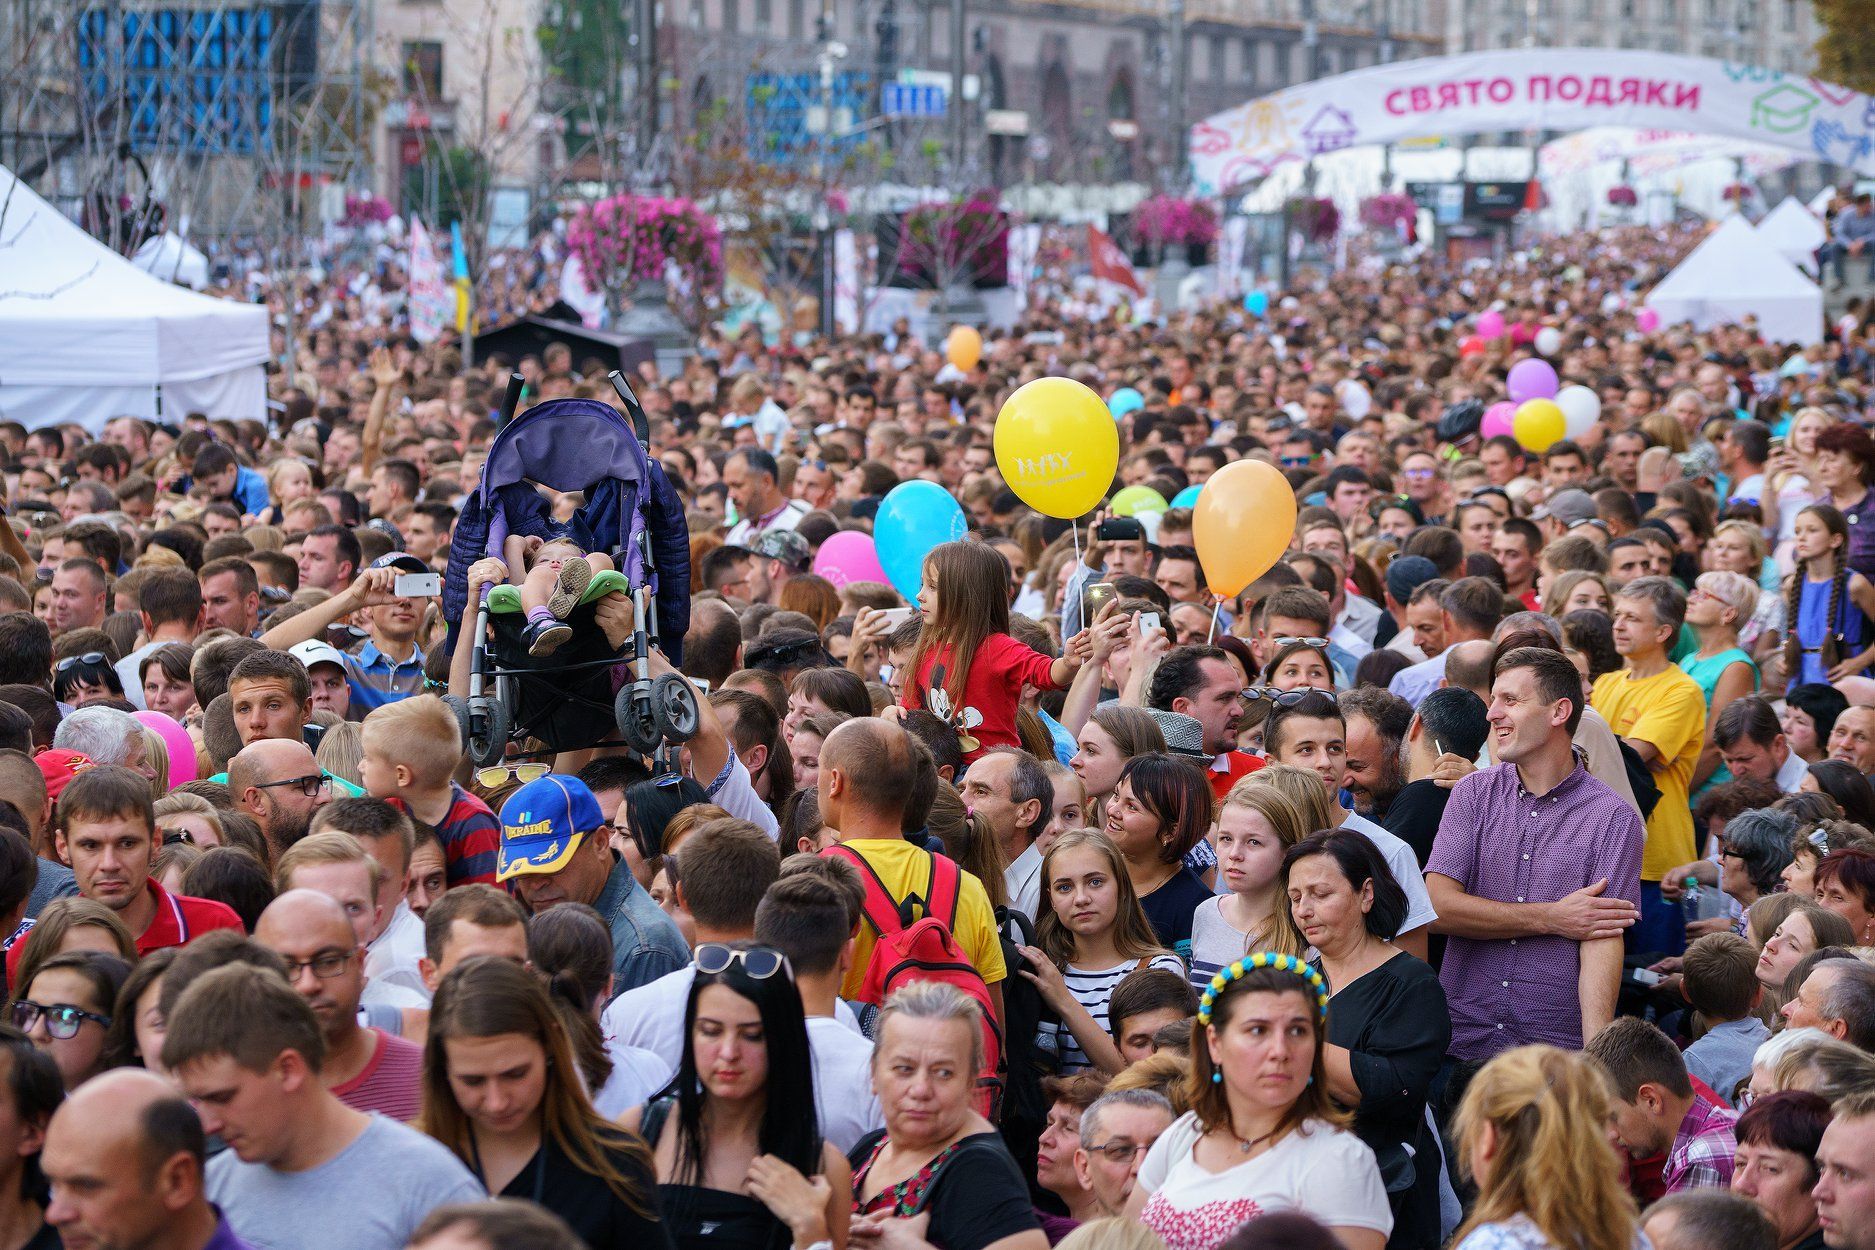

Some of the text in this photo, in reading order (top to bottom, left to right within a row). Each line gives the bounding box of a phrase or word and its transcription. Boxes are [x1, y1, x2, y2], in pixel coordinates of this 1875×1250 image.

[1385, 75, 1700, 116] СВЯТО ПОДЯКИ
[504, 819, 553, 840] UKRAINE
